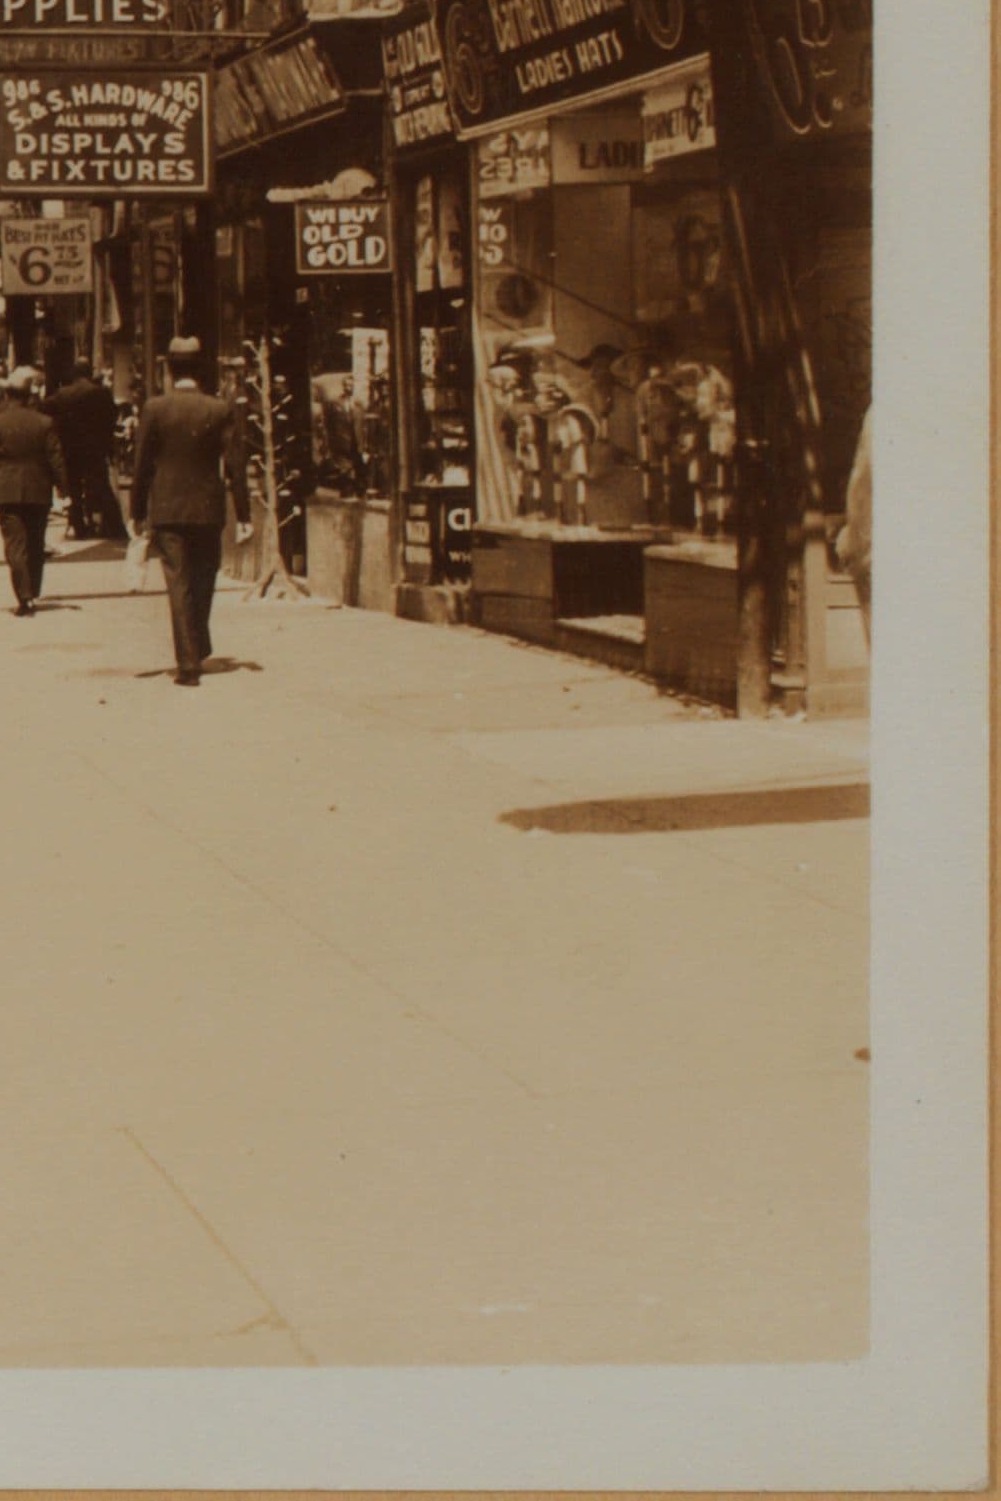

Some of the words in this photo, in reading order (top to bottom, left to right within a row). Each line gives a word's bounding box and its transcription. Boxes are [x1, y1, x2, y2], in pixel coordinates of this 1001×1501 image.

[514, 46, 575, 95] LADIES
[574, 27, 624, 74] HATS
[71, 82, 193, 132] HARDWARE
[54, 113, 81, 128] ALL
[83, 113, 127, 128] KINDS
[131, 113, 148, 128] OF
[15, 133, 186, 155] DISPLAYS
[577, 140, 644, 170] LADI
[30, 159, 196, 182] FIXTURES
[339, 206, 380, 223] BUY
[302, 225, 364, 245] OLD
[306, 235, 387, 267] GOLD
